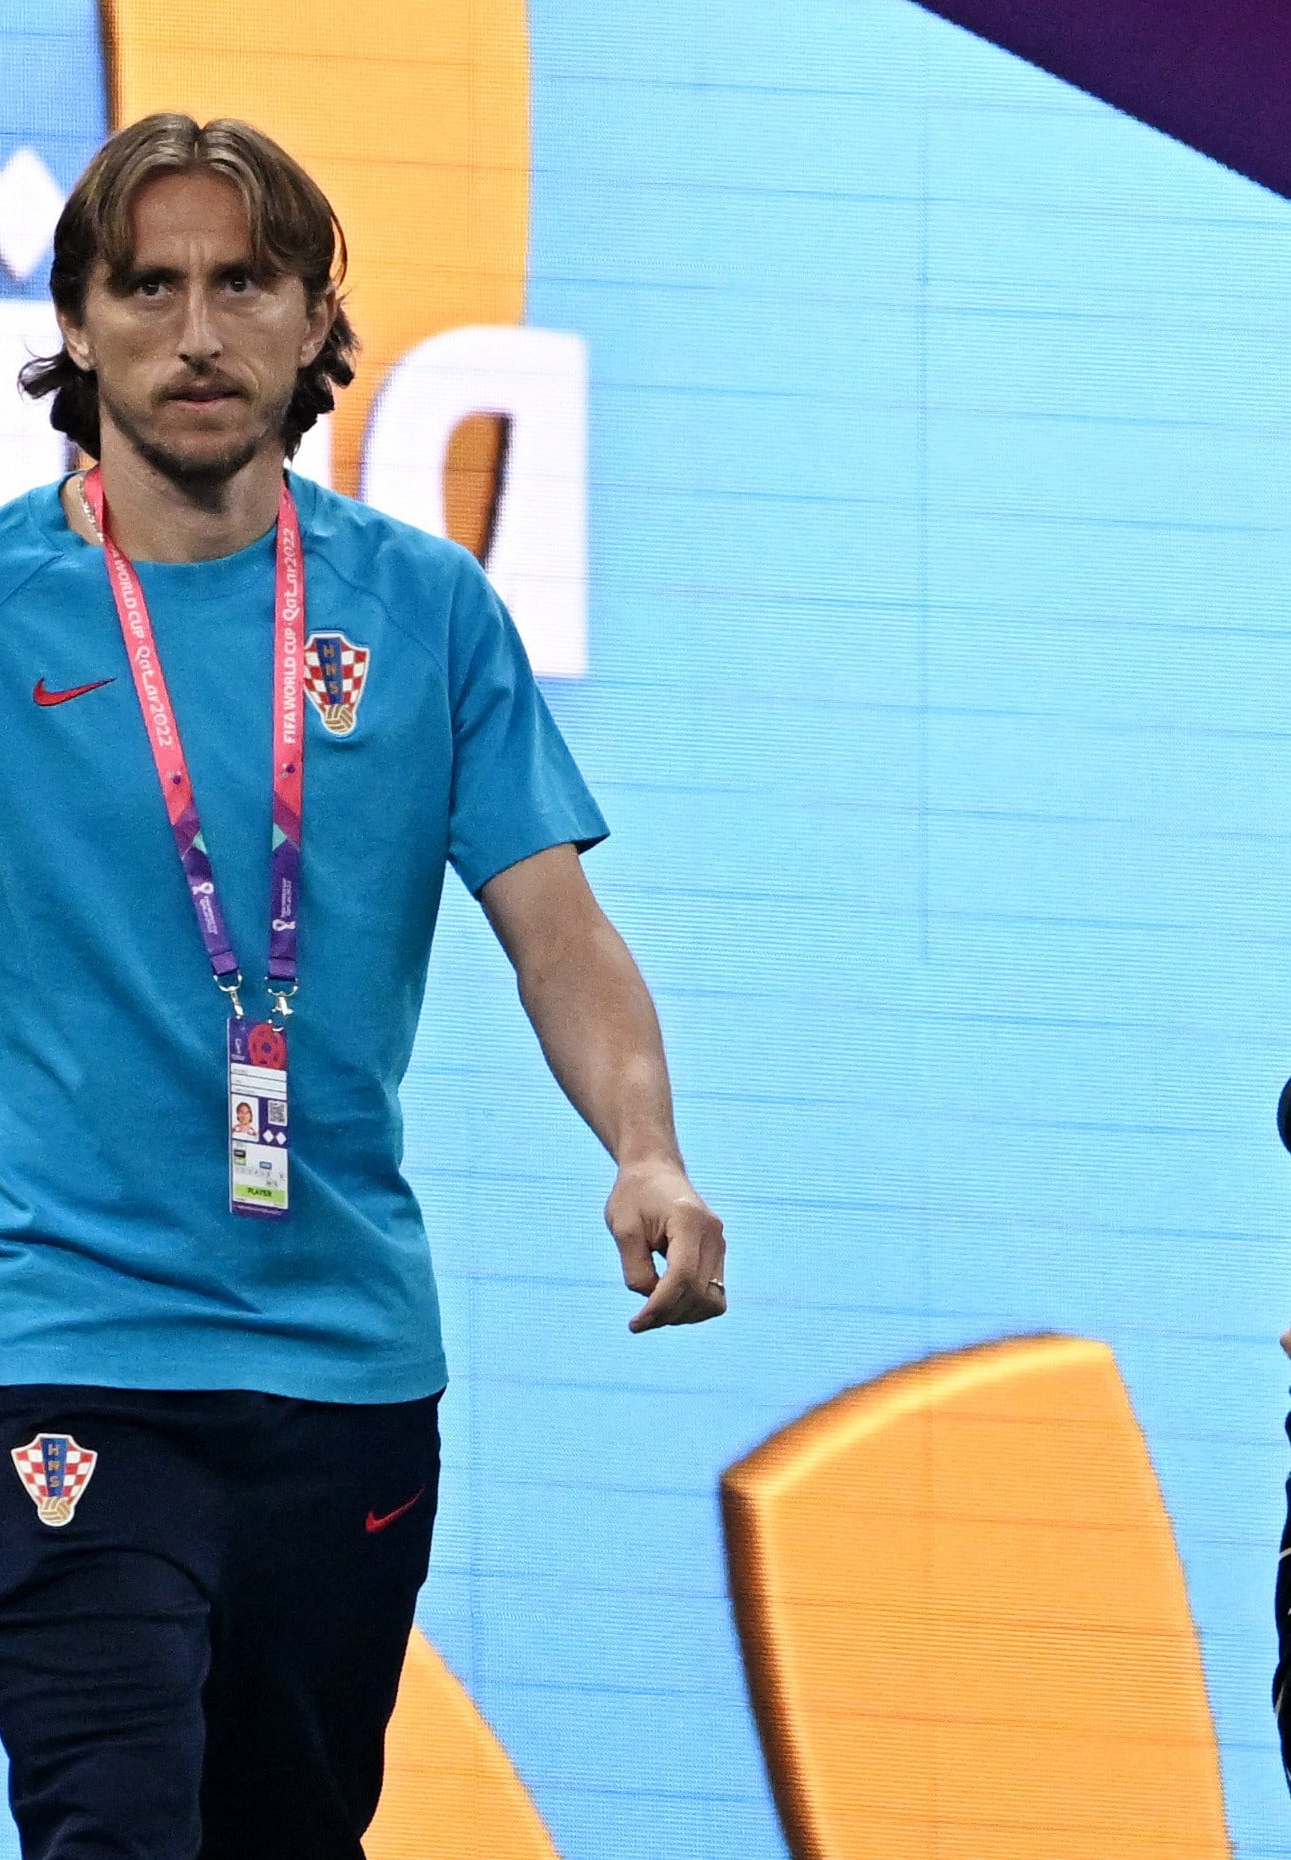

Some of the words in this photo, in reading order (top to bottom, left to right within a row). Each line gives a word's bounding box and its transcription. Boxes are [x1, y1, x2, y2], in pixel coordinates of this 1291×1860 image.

[114, 558, 138, 610] WORLD
[127, 611, 145, 639] CUP
[283, 627, 297, 655] CUP
[283, 656, 297, 710] WORLD
[283, 711, 297, 744] FIFA
